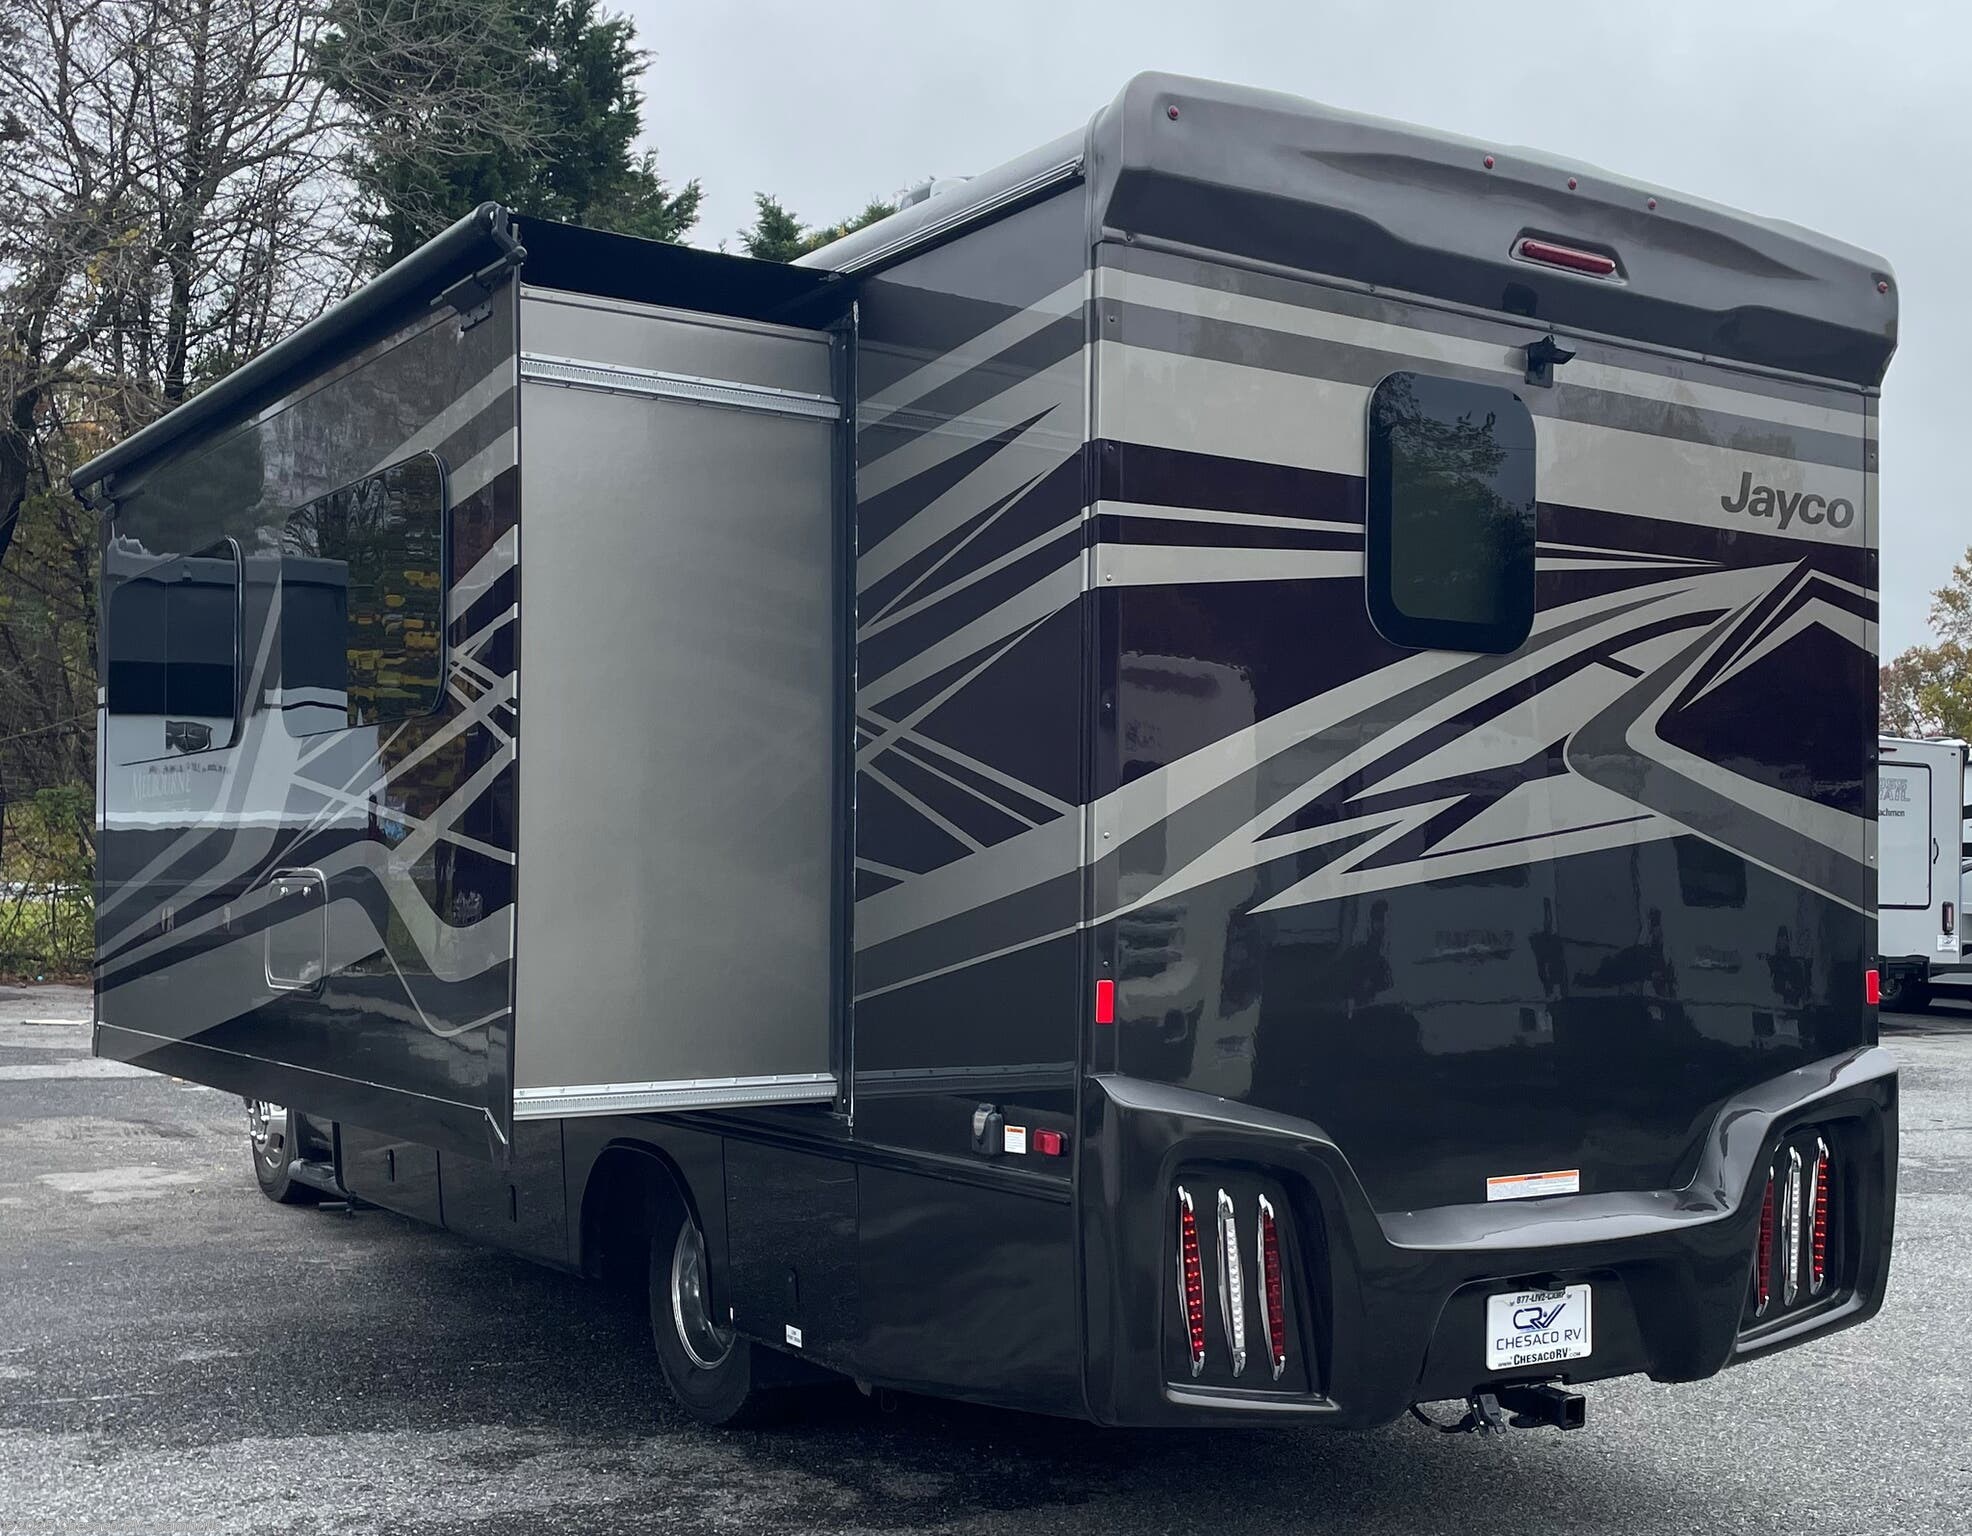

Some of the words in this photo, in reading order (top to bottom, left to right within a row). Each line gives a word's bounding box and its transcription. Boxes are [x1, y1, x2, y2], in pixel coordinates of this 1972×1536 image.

[1721, 472, 1854, 530] Jayco
[1496, 1331, 1559, 1351] CHESACO
[1564, 1328, 1582, 1341] RV
